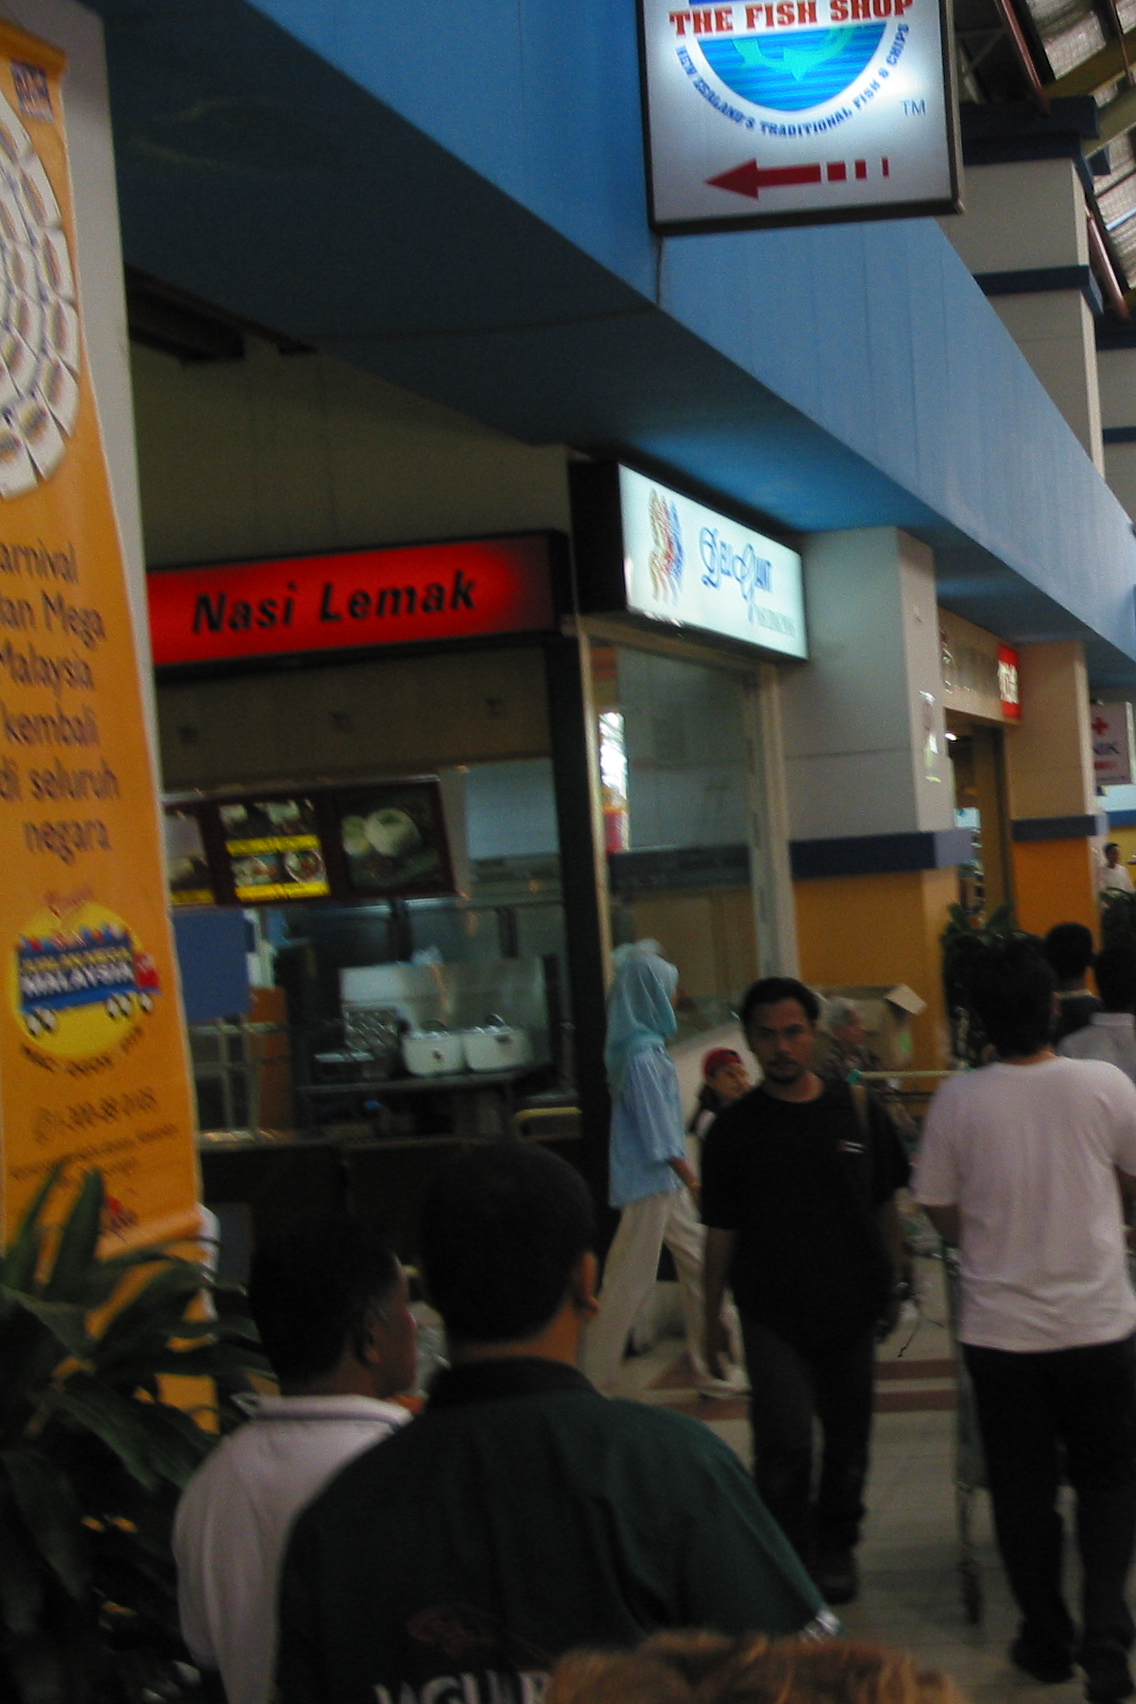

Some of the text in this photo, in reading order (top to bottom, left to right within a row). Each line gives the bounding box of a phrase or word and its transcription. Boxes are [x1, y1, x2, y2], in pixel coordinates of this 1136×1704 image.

[669, 0, 913, 36] THE FISH SHOP
[760, 107, 853, 137] TRADITIONAL
[852, 79, 880, 110] FISH
[886, 23, 909, 66] CHIPS
[903, 99, 926, 116] TM
[41, 588, 107, 651] Mega
[192, 569, 476, 634] Nasi Lemak
[1, 700, 99, 746] kembali
[23, 820, 112, 866] negara
